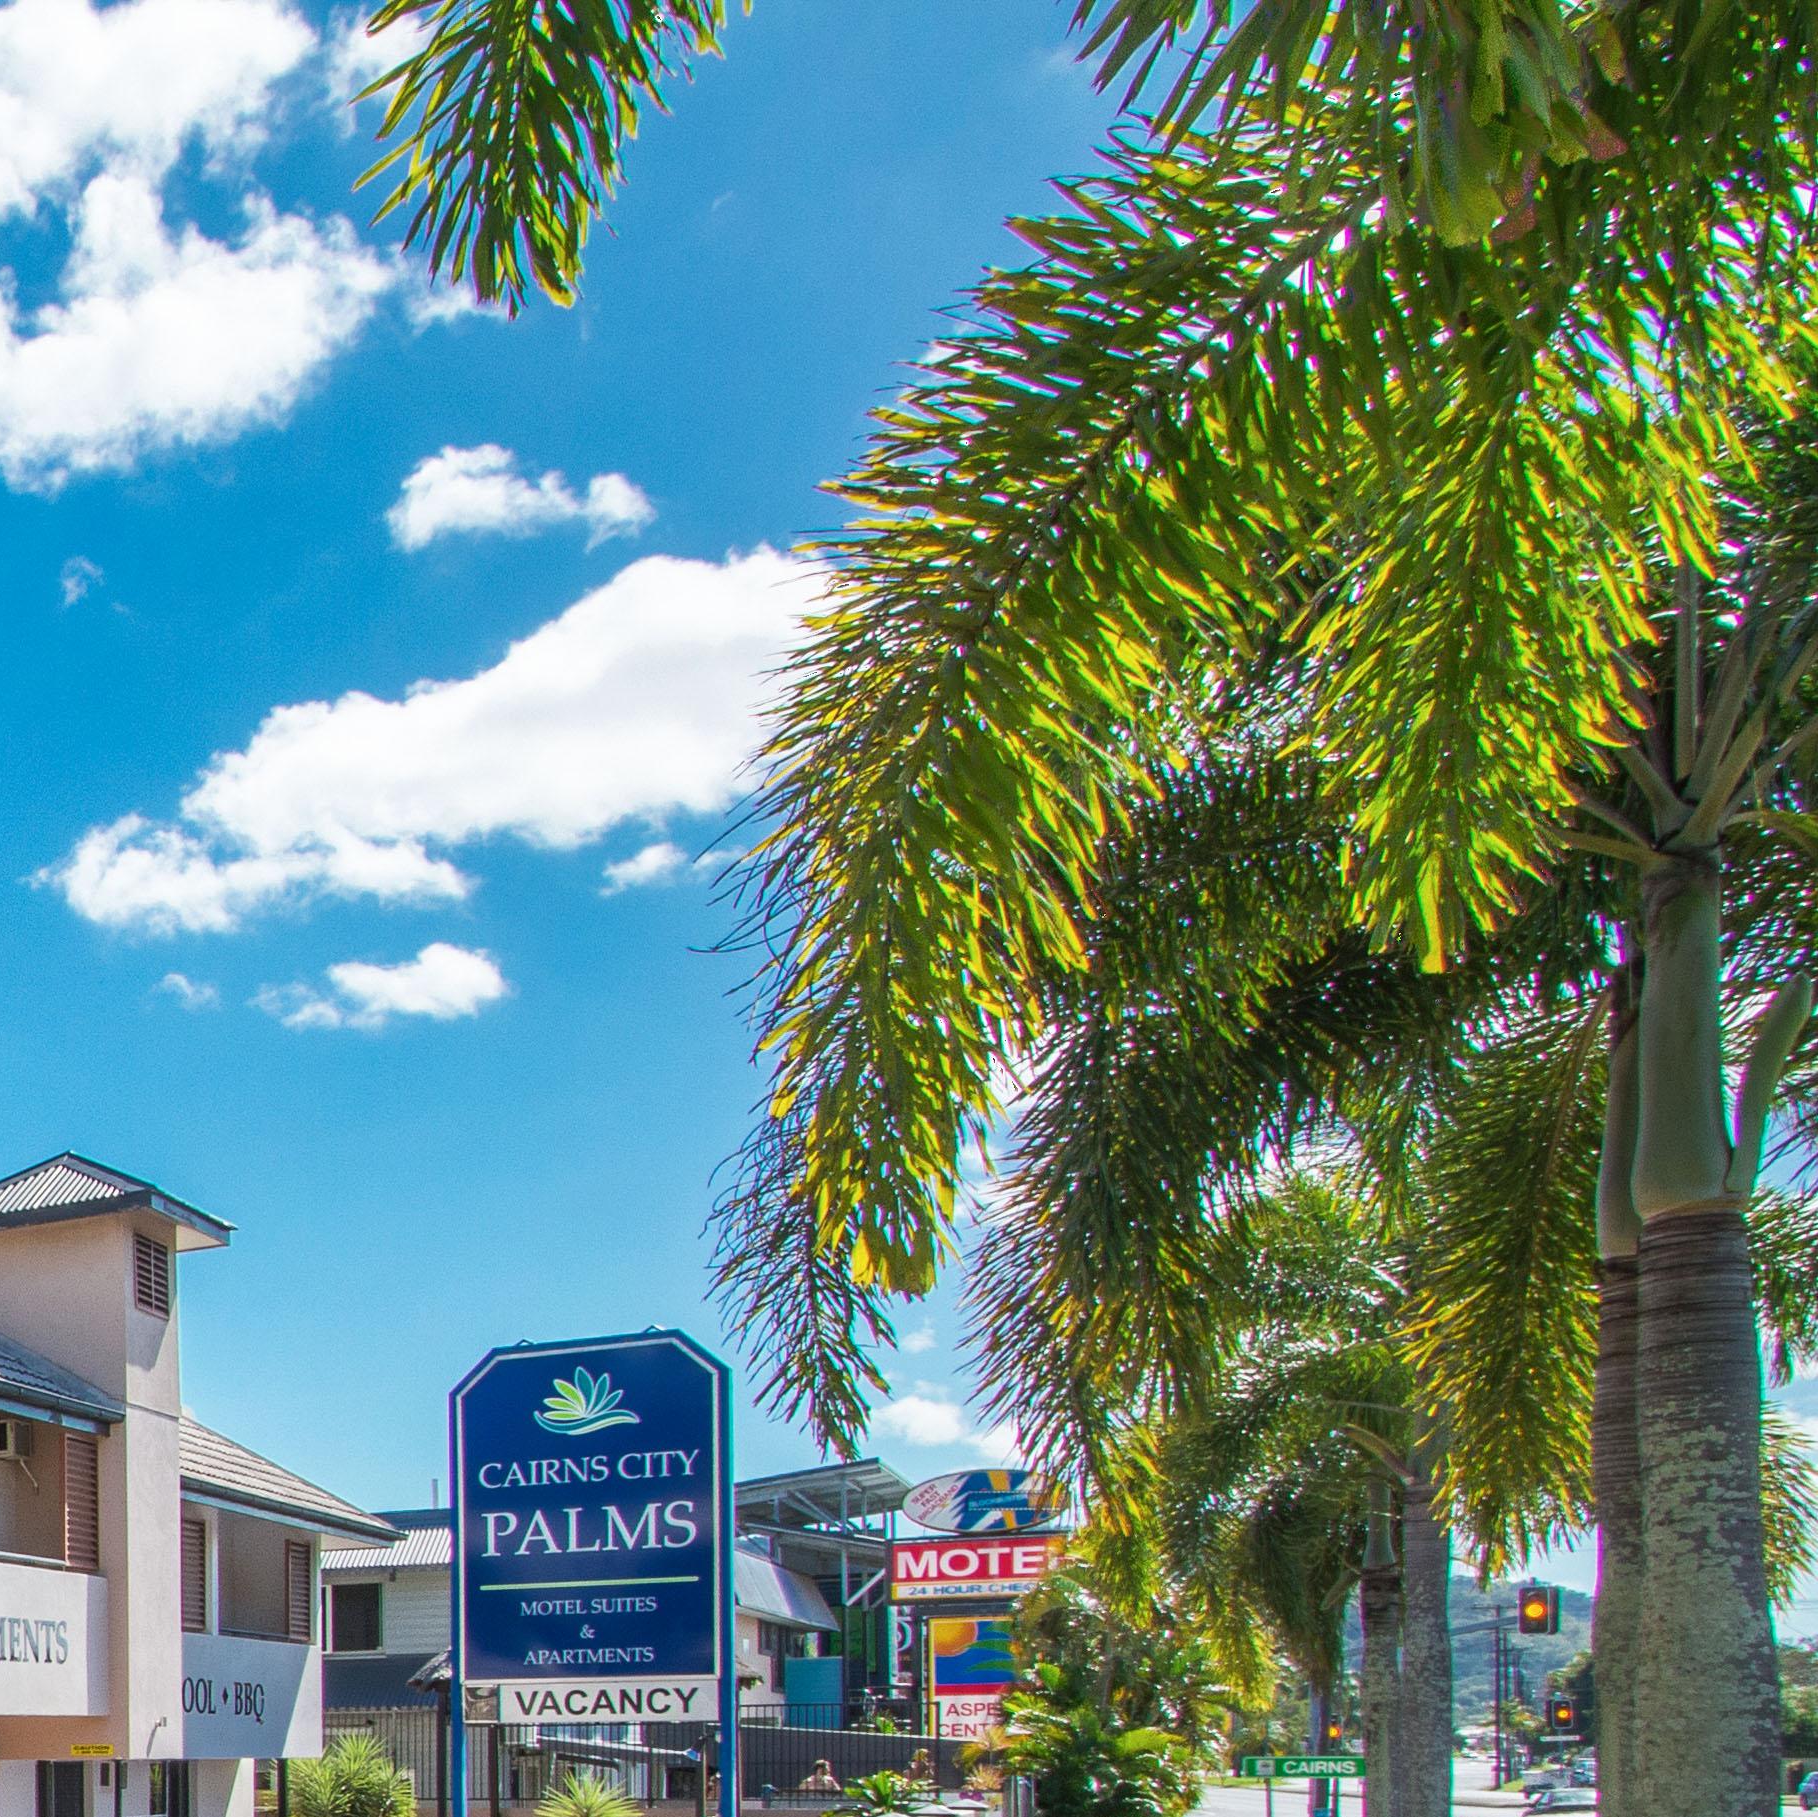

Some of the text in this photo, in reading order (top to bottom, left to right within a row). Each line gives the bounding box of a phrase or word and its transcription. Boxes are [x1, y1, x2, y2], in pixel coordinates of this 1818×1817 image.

[478, 1448, 700, 1489] CAIRNS CITY
[480, 1500, 699, 1558] PALMS
[897, 1546, 1045, 1579] MOTE
[908, 1582, 1036, 1596] 24 HOUR CHEC
[520, 1596, 657, 1617] MOTEL SUITES
[579, 1624, 595, 1639] &
[523, 1646, 655, 1666] APARTMENTS
[182, 1676, 265, 1725] OOL BBQ
[514, 1687, 700, 1717] VACANCY
[946, 1702, 998, 1717] ASPE
[939, 1722, 989, 1737] CENT
[1283, 1760, 1356, 1774] CAIRNS
